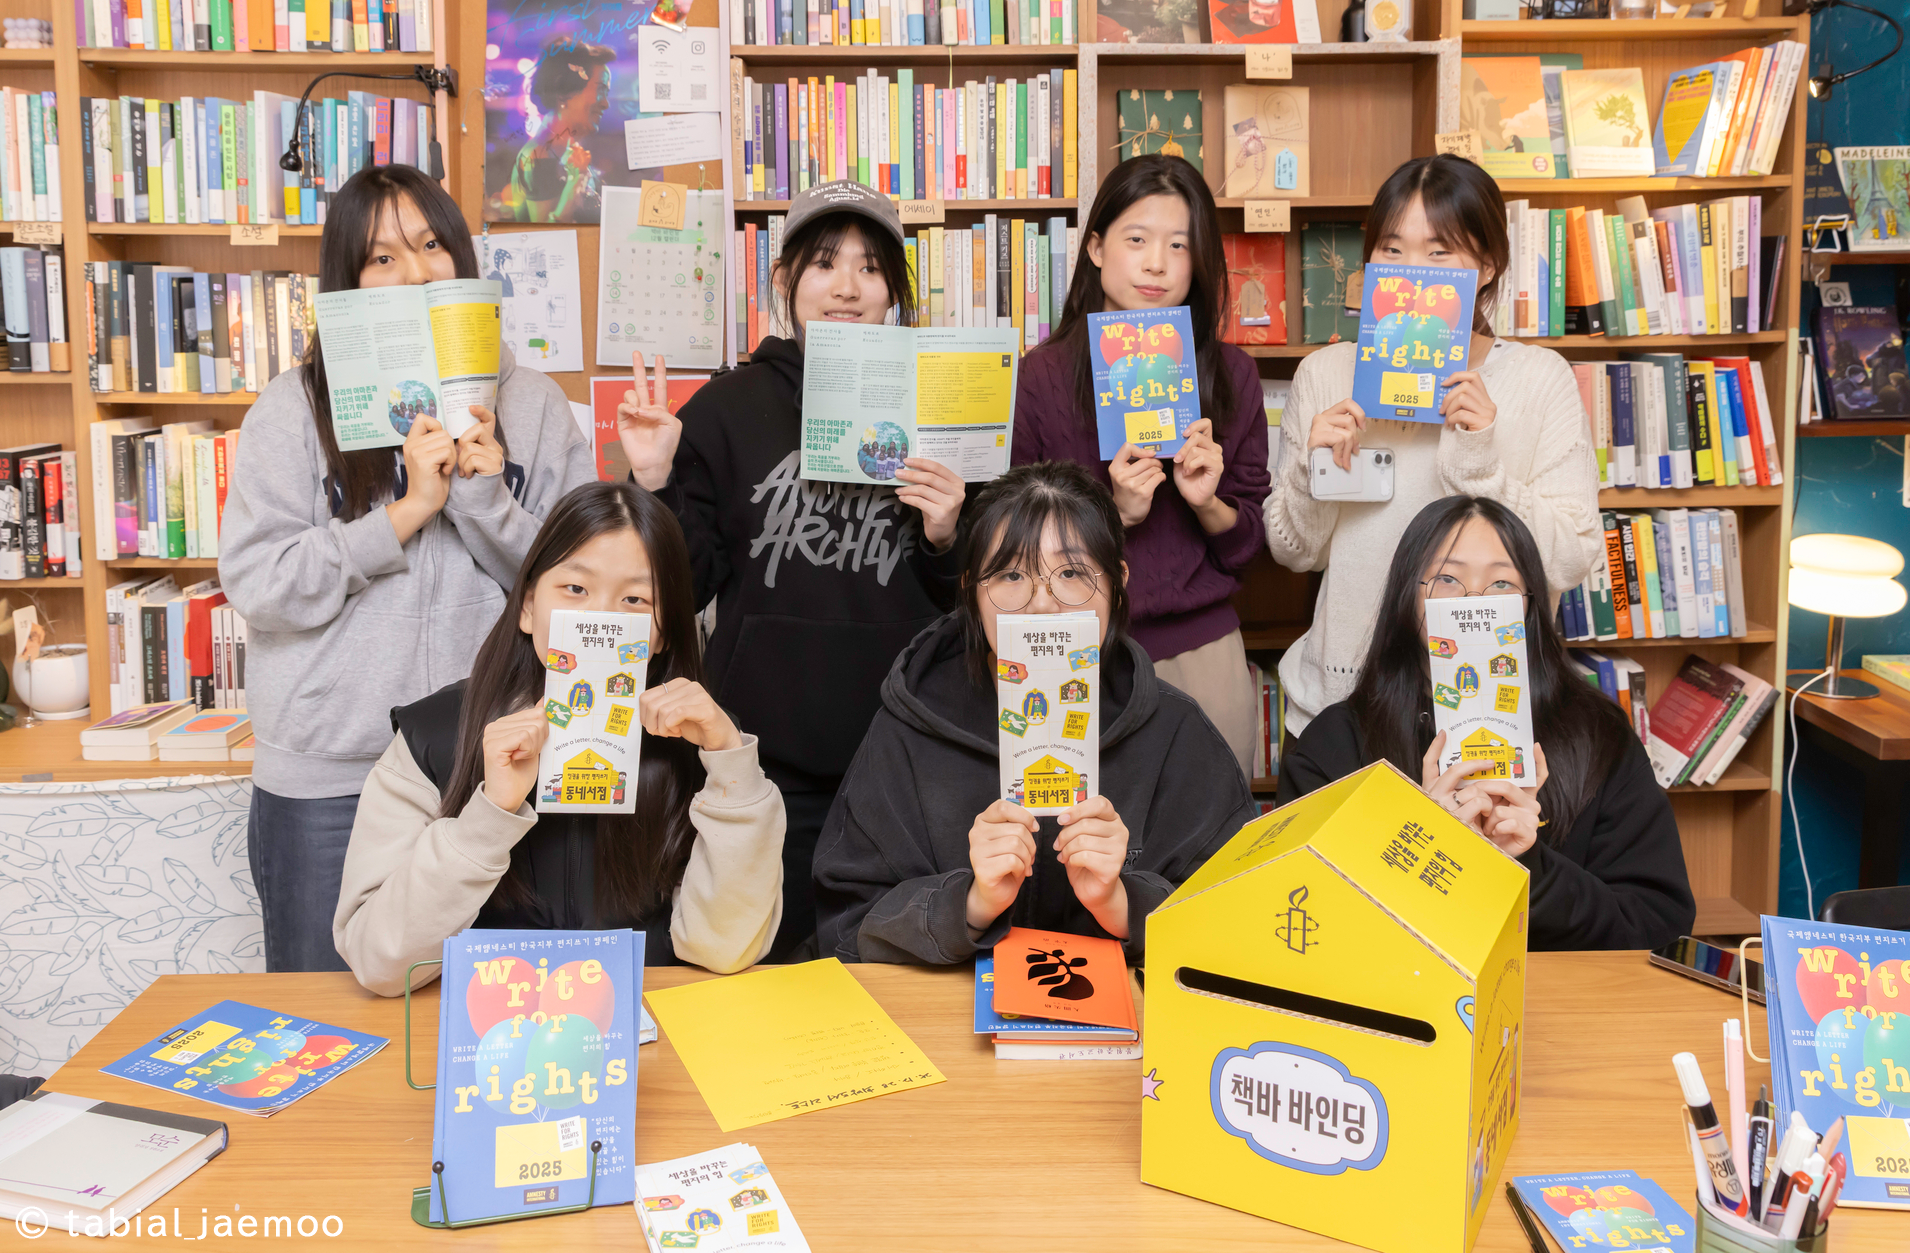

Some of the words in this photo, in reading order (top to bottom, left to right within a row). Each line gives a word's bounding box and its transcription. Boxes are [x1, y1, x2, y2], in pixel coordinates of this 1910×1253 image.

[508, 3, 657, 82] Summer
[241, 226, 264, 240] 소설
[1736, 229, 1745, 243] 부의
[1736, 244, 1745, 271] 추월차선
[1378, 276, 1456, 307] write
[1395, 310, 1431, 325] for
[1102, 323, 1175, 350] write
[1126, 352, 1157, 367] for
[1361, 337, 1464, 368] rights
[333, 388, 352, 397] 우리의
[353, 385, 378, 394] 아마존과
[1100, 378, 1194, 407] rights
[335, 396, 353, 405] 당신의
[355, 394, 373, 402] 미래를
[1394, 394, 1418, 404] 2025
[335, 404, 355, 412] 지키기
[357, 402, 369, 410] 위해
[337, 412, 362, 420] 싸웁니다
[807, 419, 826, 427] 우리의
[827, 419, 852, 428] 아마존과
[806, 427, 826, 435] 당신의
[827, 428, 846, 436] 미래를
[1139, 431, 1162, 440] 2025
[806, 435, 825, 443] 지키기
[826, 436, 839, 444] 위해
[806, 443, 831, 451] 싸웁니다
[1606, 536, 1627, 612] FACTFULNESS
[1451, 609, 1473, 620] 세상을
[1476, 609, 1497, 619] 바꾸는
[575, 623, 599, 635] 세상을
[601, 624, 623, 636] 바꾸는
[1459, 621, 1481, 632] 편지의
[1483, 621, 1491, 632] 힘
[582, 636, 604, 647] 편지의
[607, 637, 615, 648] 힘
[1023, 632, 1047, 644] 세상을
[1050, 631, 1072, 643] 바꾸는
[1030, 645, 1053, 656] 편지의
[1057, 645, 1064, 656] 힘
[1498, 697, 1515, 705] RIGHTS
[614, 707, 628, 716] WRITE
[610, 716, 627, 726] RIGHTS
[1067, 723, 1084, 731] RIGHTS
[1449, 722, 1463, 732] Write
[1484, 716, 1505, 725] change
[554, 741, 569, 752] Write
[592, 737, 613, 747] change
[1013, 749, 1028, 759] Write
[1050, 743, 1071, 752] change
[566, 786, 607, 801] 동네서점
[1029, 790, 1070, 804] 동네서점
[1397, 820, 1435, 850] 바꾸는
[1380, 839, 1420, 874] 세상을
[1434, 849, 1464, 872] 힘
[1418, 858, 1457, 896] 편지의
[466, 942, 516, 954] 국제앰네스티
[520, 940, 553, 951] 한국지부
[557, 938, 590, 948] 편지쓰기
[594, 935, 618, 946] 캠페인
[1787, 929, 1836, 942] 국제앰네스티
[1840, 933, 1871, 943] 한국지부
[1874, 934, 1906, 946] 편지쓰기
[473, 958, 602, 1008] write
[510, 1011, 567, 1038] for
[1843, 1005, 1896, 1030] for
[170, 1030, 205, 1050] 2025
[1791, 1029, 1814, 1037] WRITE
[1824, 1031, 1849, 1039] LETTER
[453, 1045, 476, 1053] WRITE
[486, 1042, 514, 1050] LETTER
[1793, 1039, 1819, 1047] CHANGE
[1829, 1040, 1847, 1048] LIFE
[173, 1016, 293, 1091] rights
[452, 1054, 480, 1063] CHANGE
[490, 1052, 509, 1060] LIFE
[253, 1048, 298, 1076] for
[257, 1042, 359, 1098] write
[454, 1058, 628, 1115] rights
[1800, 1053, 1910, 1107] righ
[1230, 1072, 1281, 1123] 책바
[1288, 1087, 1366, 1145] 바인딩
[560, 1120, 576, 1129] WRITE
[596, 1125, 621, 1136] 편지에는
[140, 1133, 180, 1148] 모순
[562, 1131, 580, 1141] RIGHTS
[519, 1160, 562, 1180] 2025
[668, 1167, 698, 1181] 세상을
[700, 1161, 728, 1172] 바꾸는
[681, 1174, 710, 1187] 편지의
[712, 1171, 723, 1179] 힘
[526, 1190, 546, 1198] AMNESTY
[1540, 1185, 1632, 1206] write
[1584, 1206, 1622, 1218] for
[1568, 1224, 1686, 1248] rights
